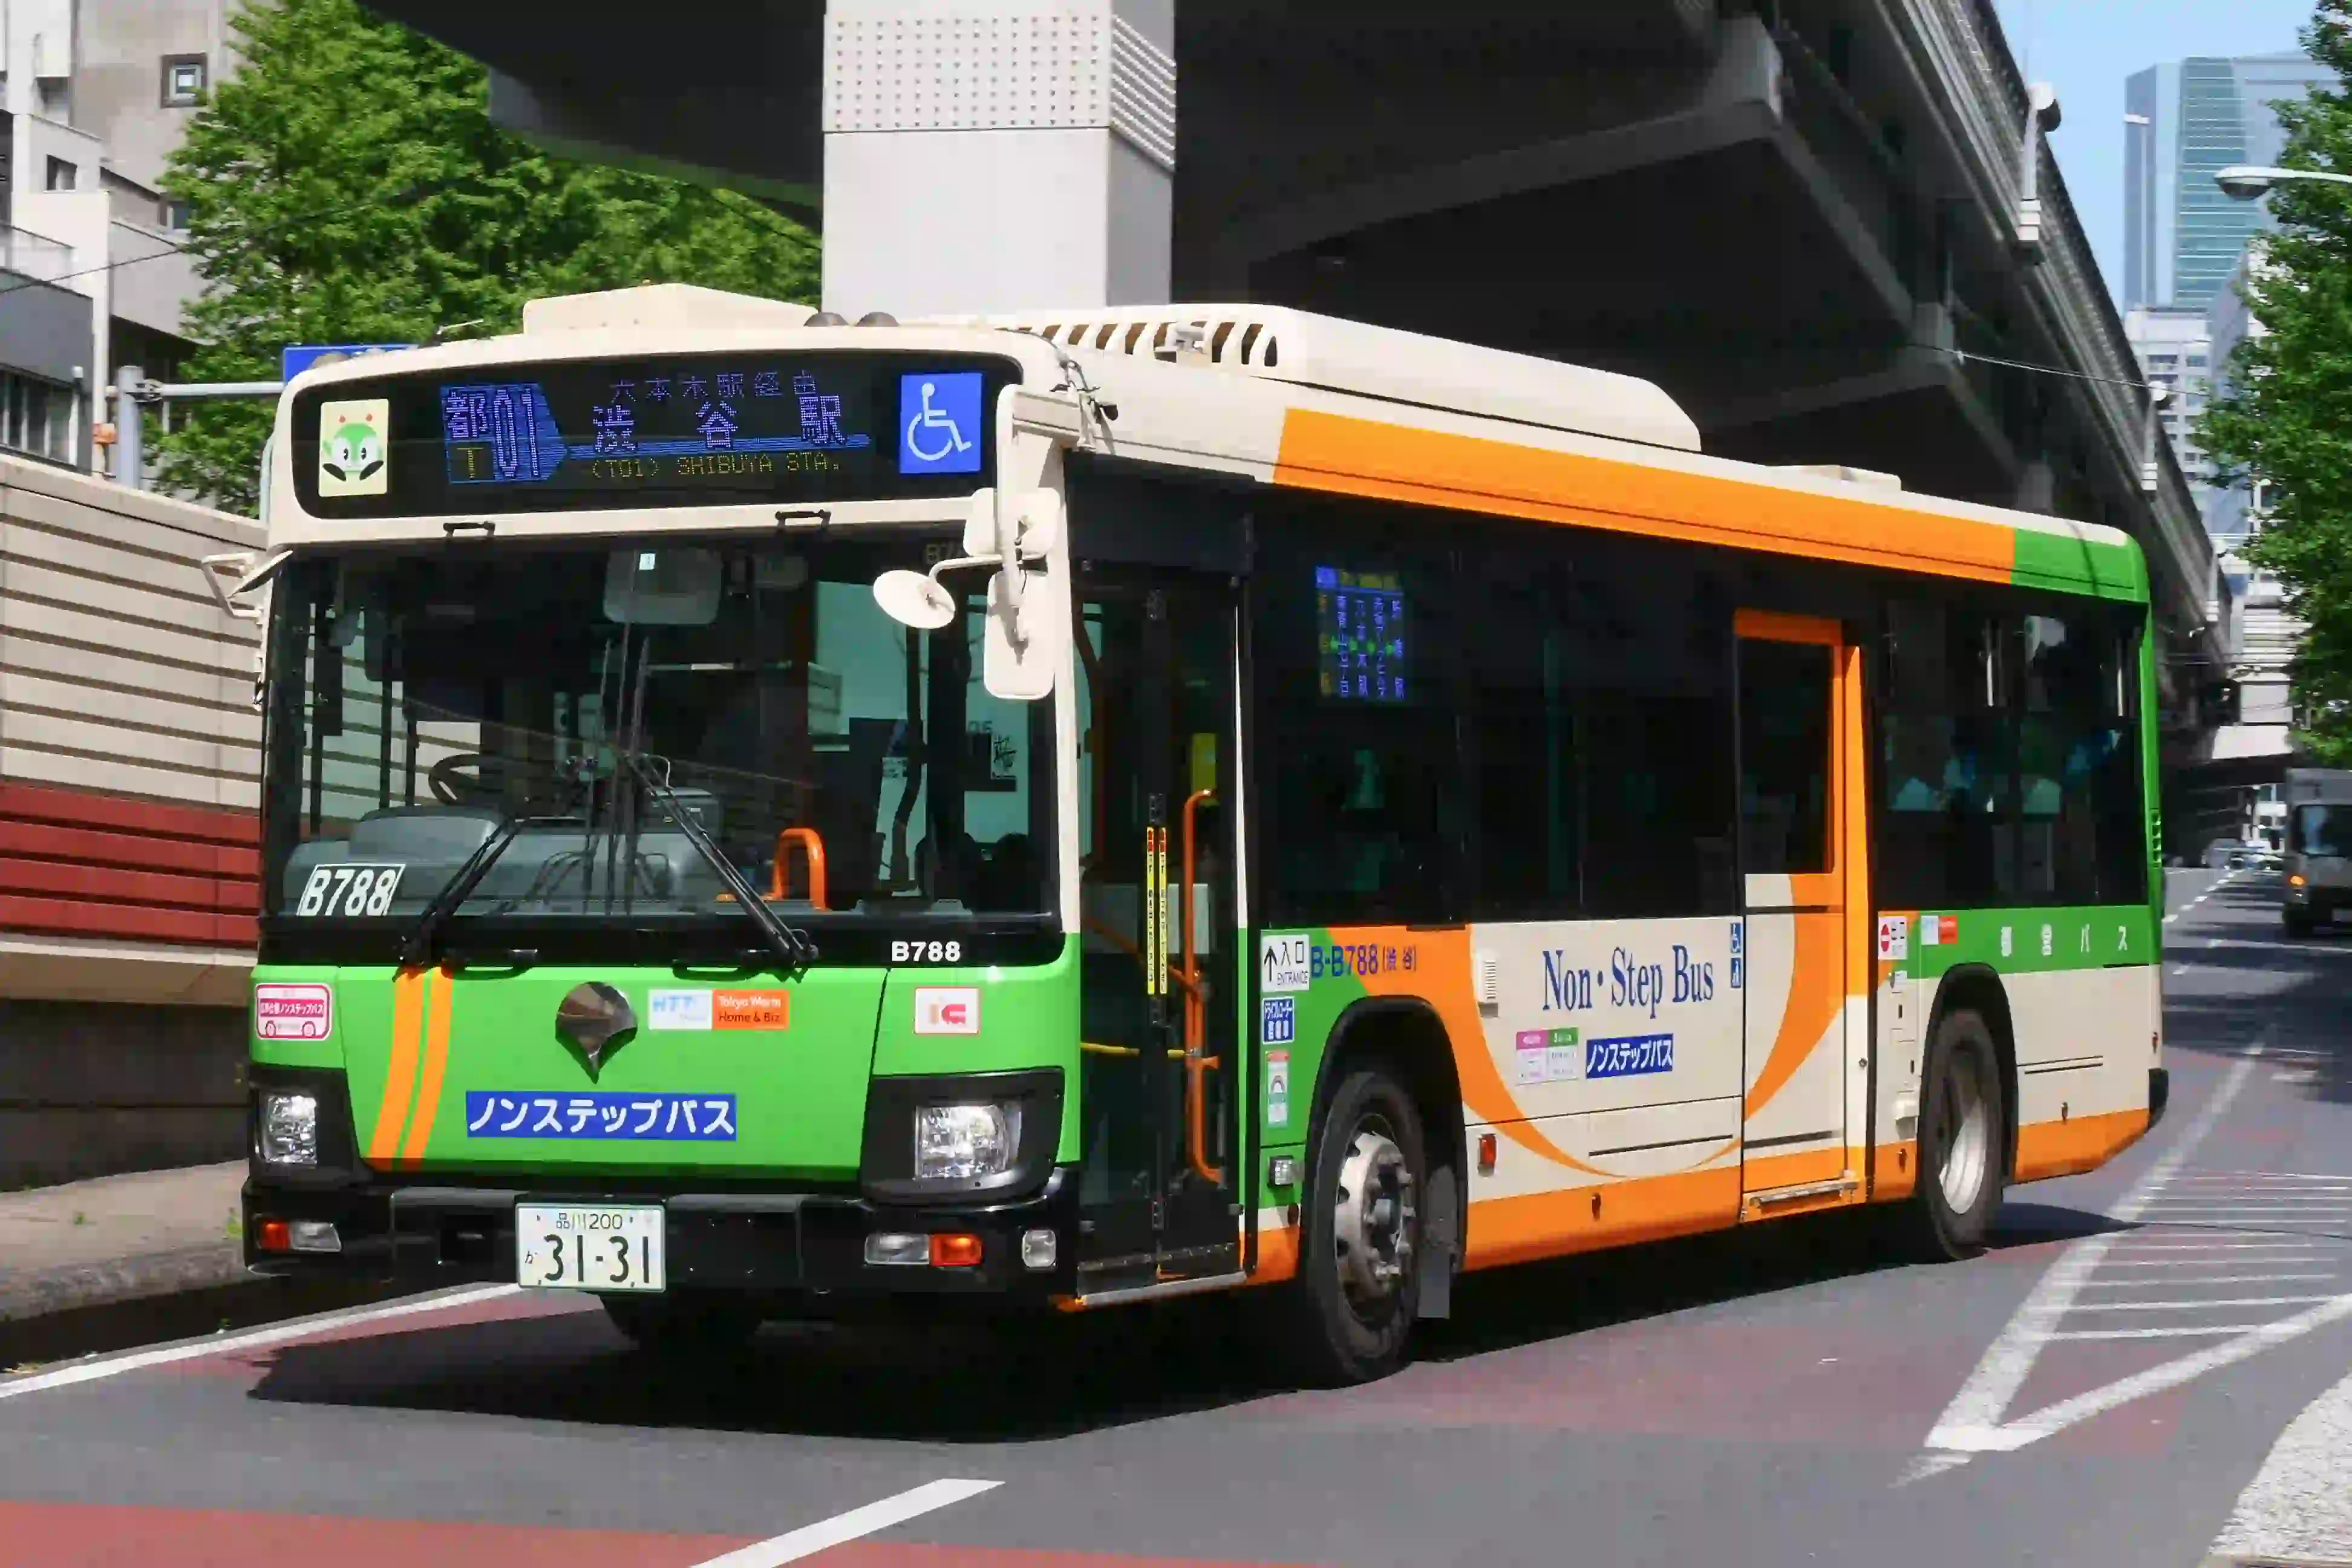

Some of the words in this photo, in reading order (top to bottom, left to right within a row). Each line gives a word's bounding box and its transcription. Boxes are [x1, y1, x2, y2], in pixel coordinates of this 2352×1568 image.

[610, 370, 817, 403] 六本木駅経由
[593, 394, 846, 452] 渋谷駅
[592, 457, 659, 478] (T01)
[677, 454, 773, 476] SHIBUYA
[786, 451, 840, 471] STA.
[298, 869, 397, 916] B788
[891, 941, 961, 962] B788
[1281, 941, 1304, 966] 入口
[1310, 943, 1379, 978] B-B788
[1276, 970, 1309, 986] ENTRANCE
[1671, 944, 1714, 1003] Bus
[719, 995, 748, 1010] Tokyo
[719, 1011, 751, 1022] Home
[753, 1012, 761, 1022] &
[763, 1012, 781, 1022] Biz
[1586, 1040, 1673, 1074] ノンステップバス
[469, 1097, 735, 1134] ノンステップバス
[555, 1212, 623, 1230] 品川200
[543, 1234, 650, 1284] 31-31
